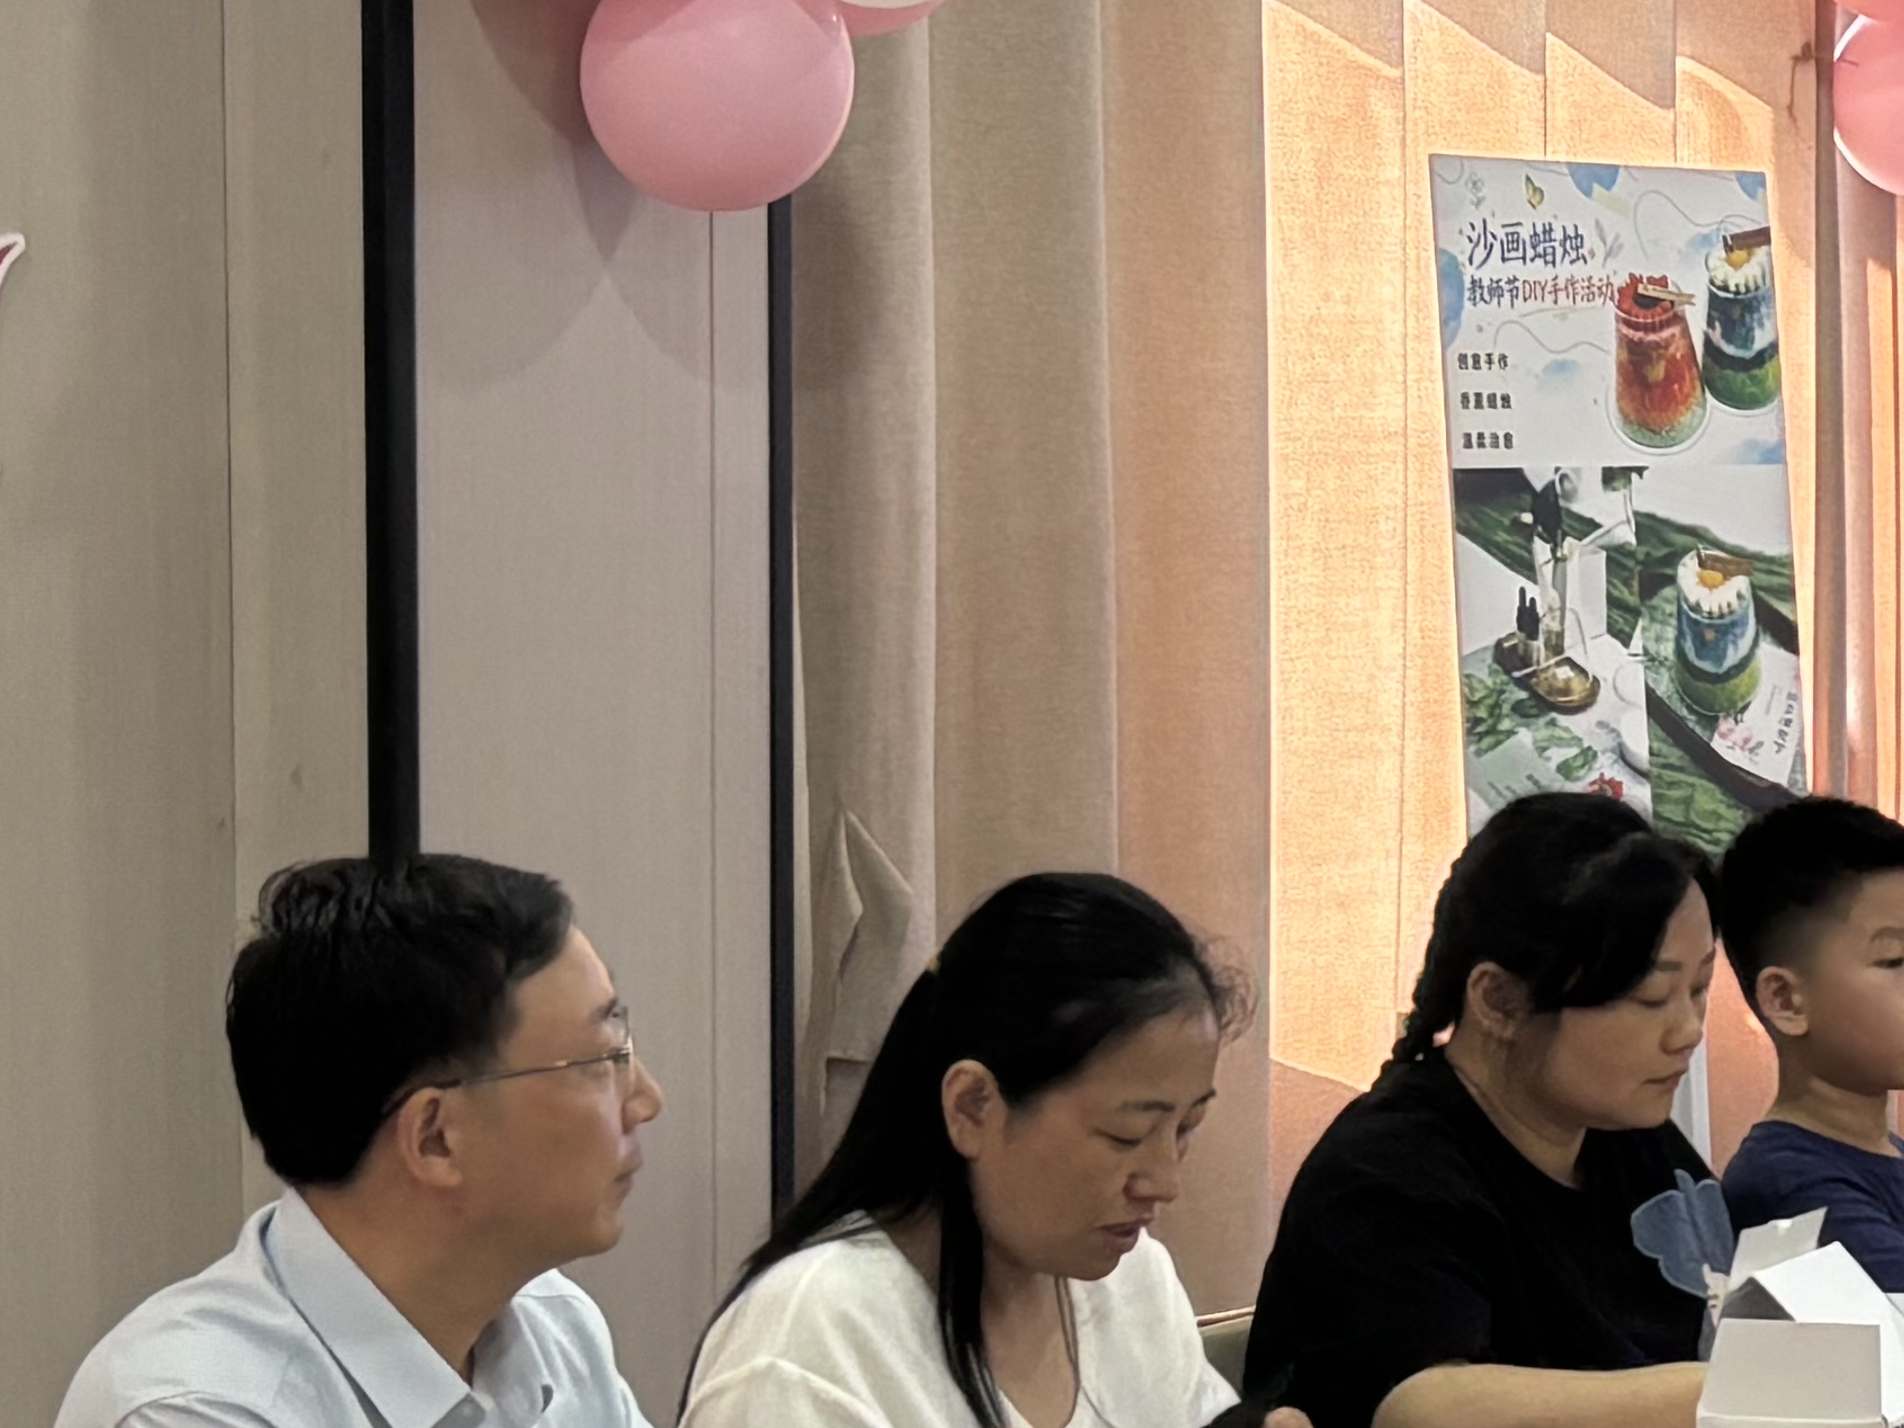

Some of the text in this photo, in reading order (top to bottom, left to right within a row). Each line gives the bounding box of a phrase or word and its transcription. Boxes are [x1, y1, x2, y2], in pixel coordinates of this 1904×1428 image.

[1467, 218, 1588, 270] 沙画蜡烛
[1467, 274, 1615, 309] 教师节DIY手作活动
